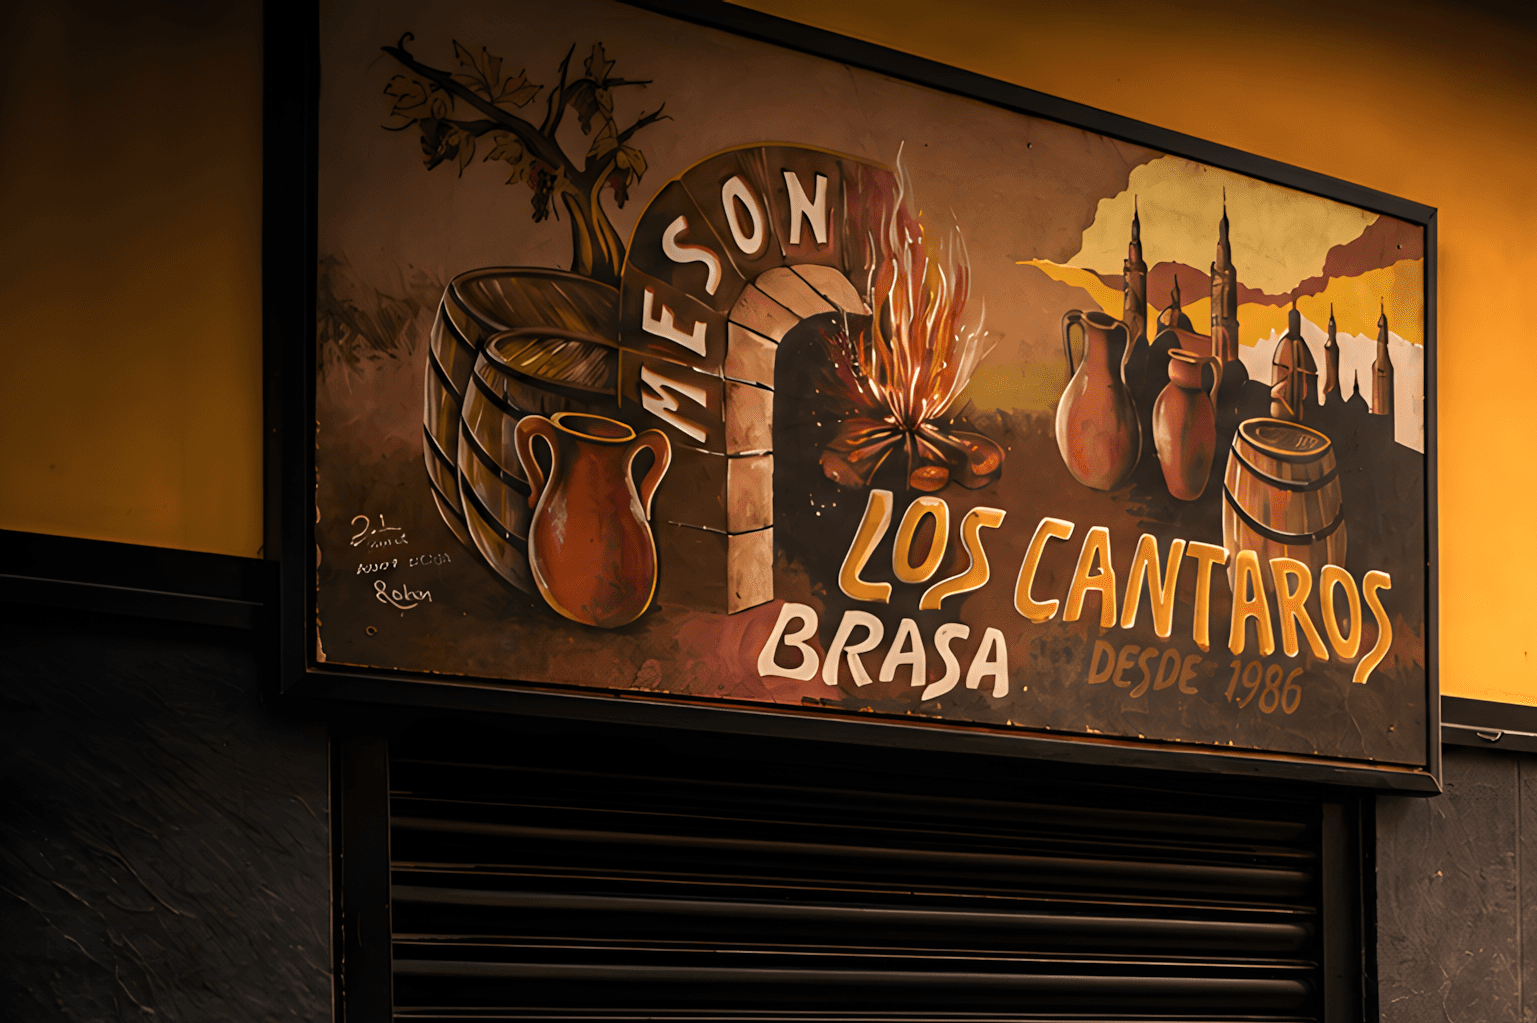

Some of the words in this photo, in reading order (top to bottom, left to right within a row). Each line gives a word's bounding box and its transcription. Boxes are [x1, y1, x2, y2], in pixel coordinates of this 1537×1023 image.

[641, 171, 828, 444] MESON
[757, 602, 1009, 701] BRASA
[838, 489, 1006, 611] LOS
[1014, 517, 1393, 684] CANTAROS
[1088, 639, 1202, 698] DESDE
[1224, 659, 1303, 715] 1986
